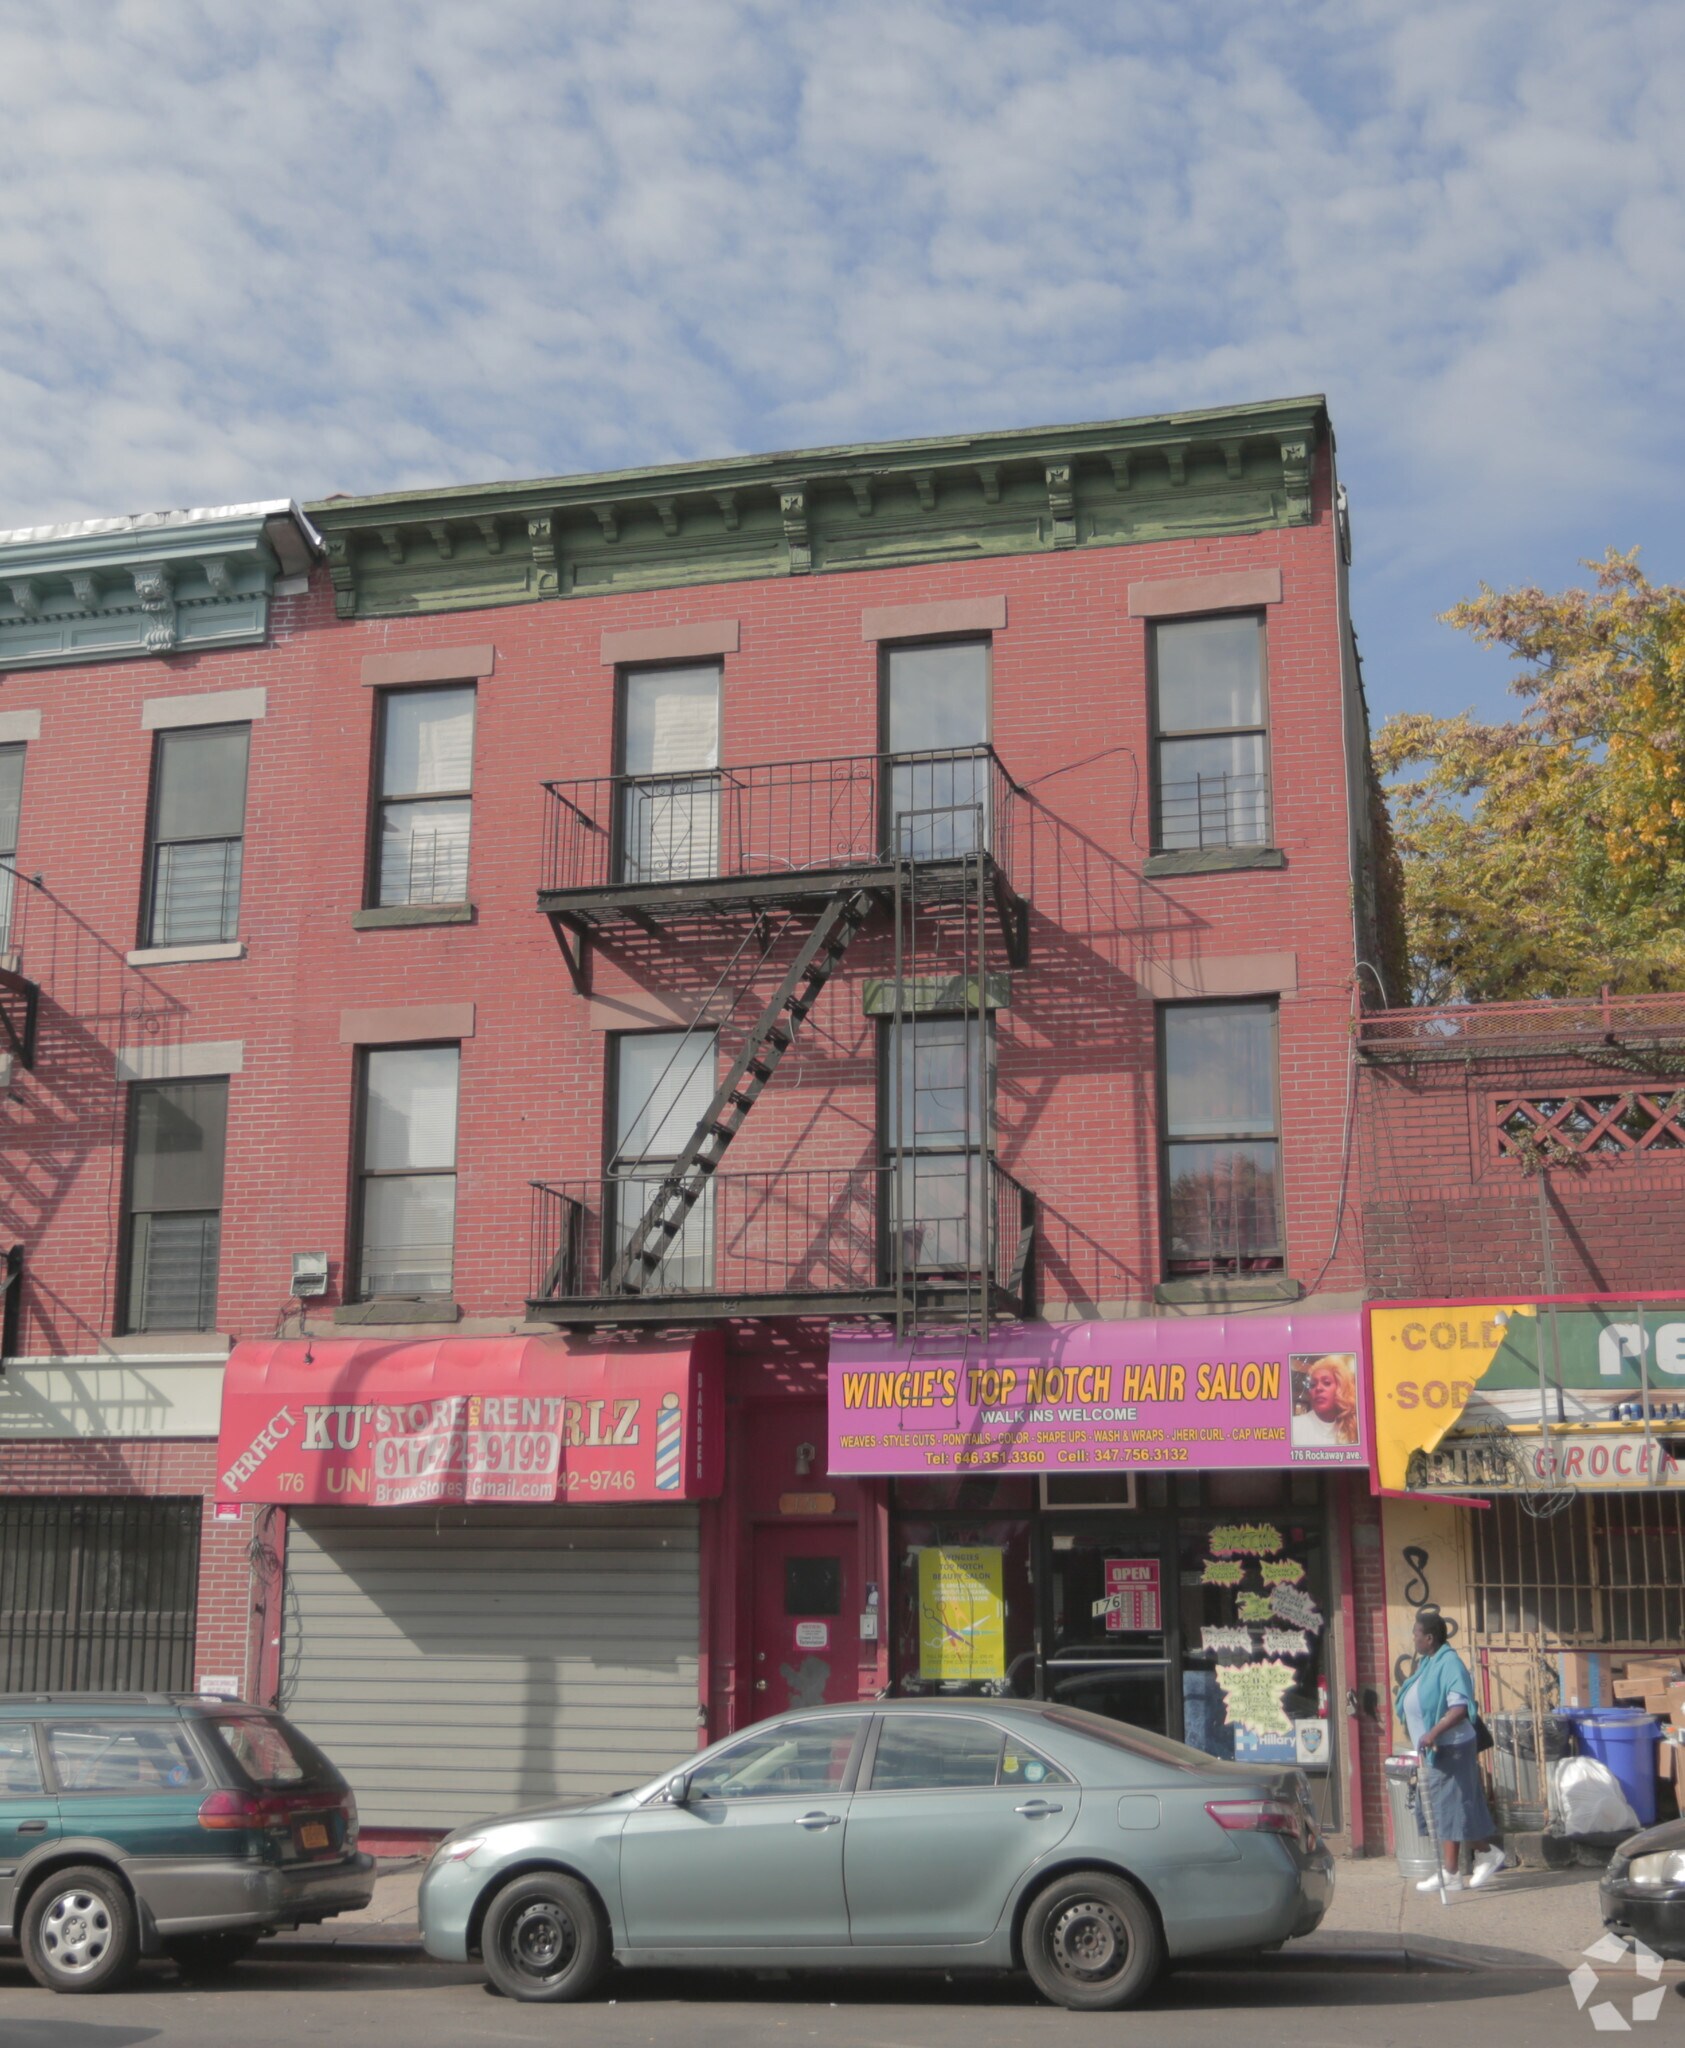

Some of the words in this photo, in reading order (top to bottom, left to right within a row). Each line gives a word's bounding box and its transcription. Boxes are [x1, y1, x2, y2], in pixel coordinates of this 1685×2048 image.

[842, 1367, 957, 1409] WINGIE'S
[967, 1368, 1017, 1406] TOP
[1026, 1364, 1112, 1404] NOTCH
[1122, 1363, 1187, 1402] HAIR
[1196, 1362, 1281, 1401] SALON
[376, 1397, 466, 1433] STORE
[469, 1396, 481, 1427] FOR
[483, 1397, 561, 1426] RENT
[981, 1410, 1025, 1424] WALK
[1029, 1409, 1054, 1423] INS
[1058, 1407, 1137, 1422] WELCOME
[839, 1435, 876, 1448] WEAVES
[883, 1434, 910, 1447] STYLE
[912, 1433, 935, 1447] CUTS
[942, 1432, 991, 1446] PONYTAILS
[999, 1432, 1030, 1445] COLOR
[1036, 1430, 1066, 1444] SHAPE
[1068, 1430, 1087, 1443] UPS
[1093, 1429, 1120, 1442] WASH
[1122, 1430, 1129, 1442] &
[1131, 1429, 1165, 1442] WRAPS
[1171, 1428, 1198, 1441] JHERI
[1200, 1428, 1225, 1441] CURL
[1232, 1428, 1251, 1441] CAP
[1253, 1427, 1286, 1441] WEAVE
[221, 1405, 297, 1493] PERFECT
[382, 1434, 551, 1478] 917-225-9199
[924, 1451, 949, 1465] Tel:
[954, 1450, 1045, 1465] 646.351.3360
[1057, 1449, 1090, 1463] Cell:
[1094, 1447, 1188, 1462] 347.756.3132
[1290, 1450, 1304, 1460] 176
[1305, 1449, 1344, 1462] Rockaway
[1346, 1450, 1362, 1461] ave.
[277, 1473, 304, 1492] 176
[1112, 1567, 1151, 1581] OPEN
[1095, 1595, 1120, 1615] 176
[1260, 1733, 1297, 1748] Hillary
